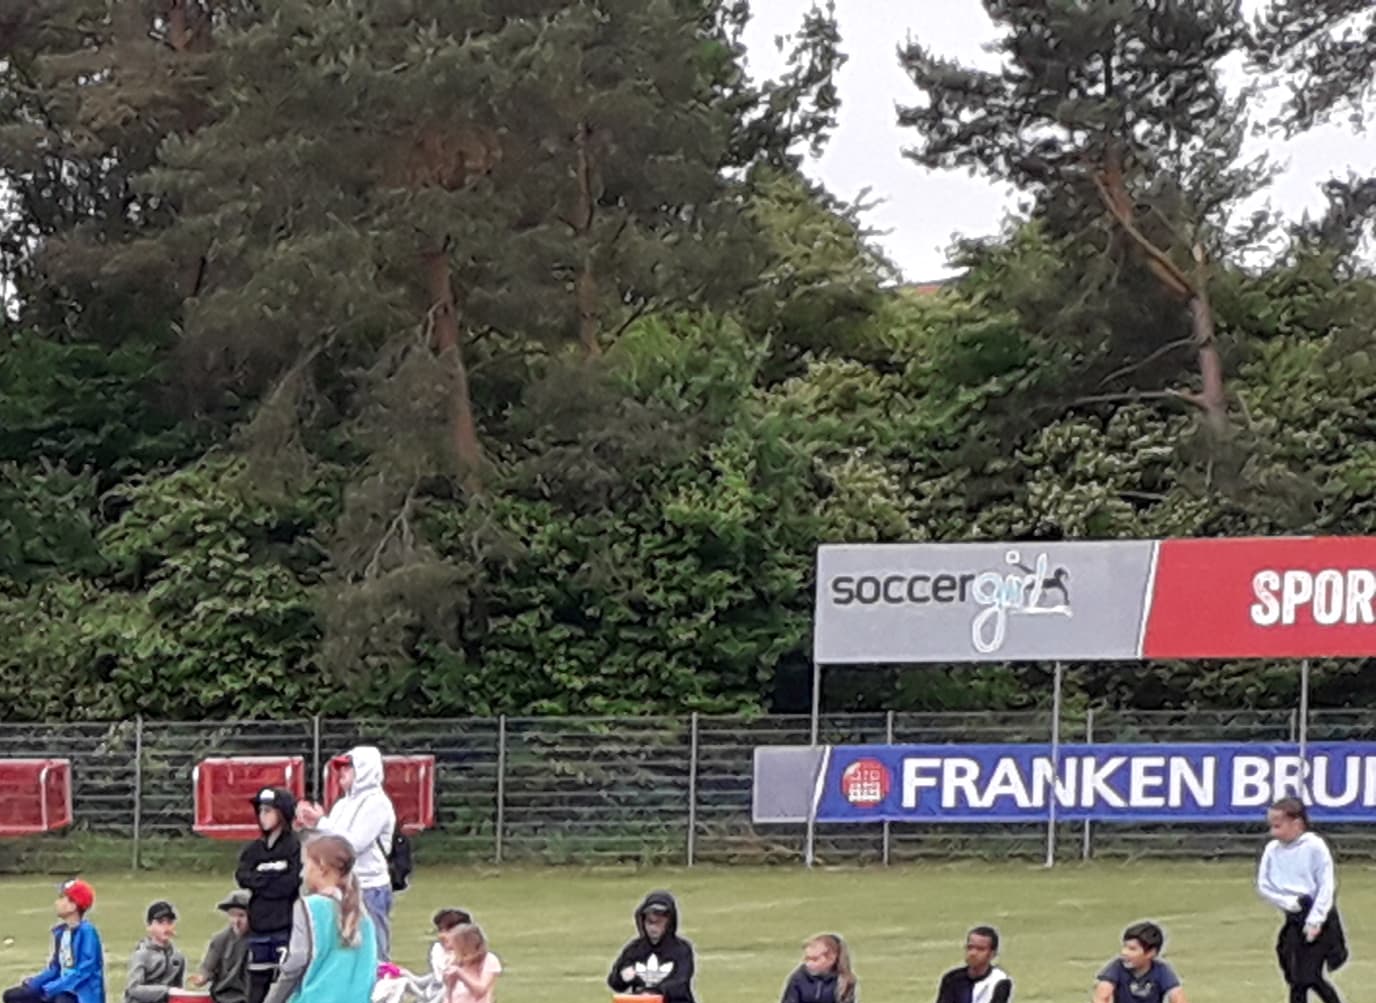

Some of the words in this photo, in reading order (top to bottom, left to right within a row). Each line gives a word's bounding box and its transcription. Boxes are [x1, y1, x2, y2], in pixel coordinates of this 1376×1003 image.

[831, 551, 1070, 653] soccergirl
[901, 757, 1215, 808] FRANKEN
[1231, 755, 1376, 808] BRU
